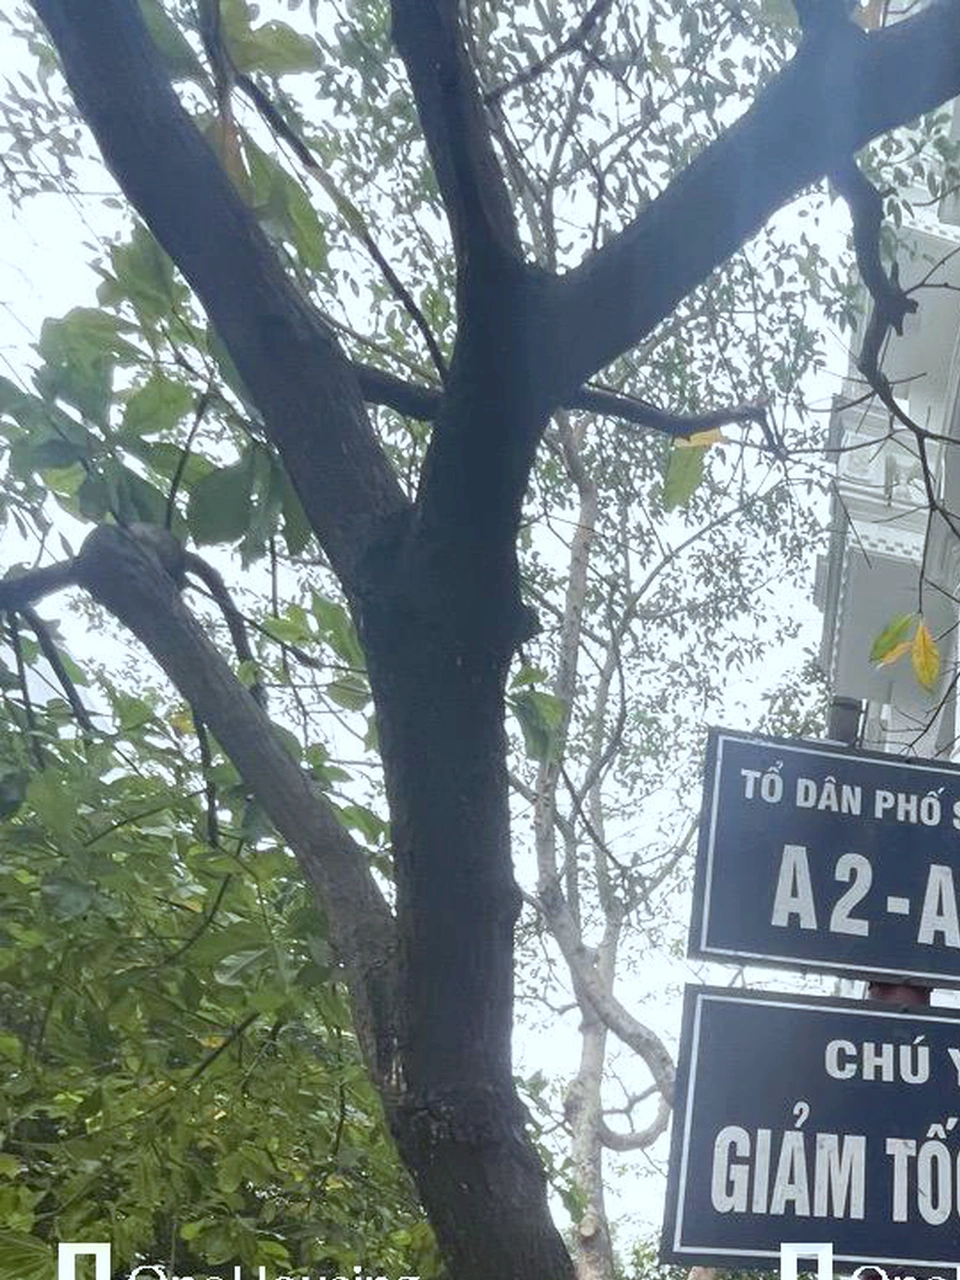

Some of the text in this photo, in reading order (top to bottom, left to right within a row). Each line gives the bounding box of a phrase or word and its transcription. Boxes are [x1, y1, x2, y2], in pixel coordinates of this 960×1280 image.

[741, 761, 783, 803] TỔ
[796, 778, 862, 816] DÂN
[874, 787, 942, 827] PHỐ
[825, 1036, 930, 1084] CHÚ
[711, 1101, 866, 1220] GIẢM
